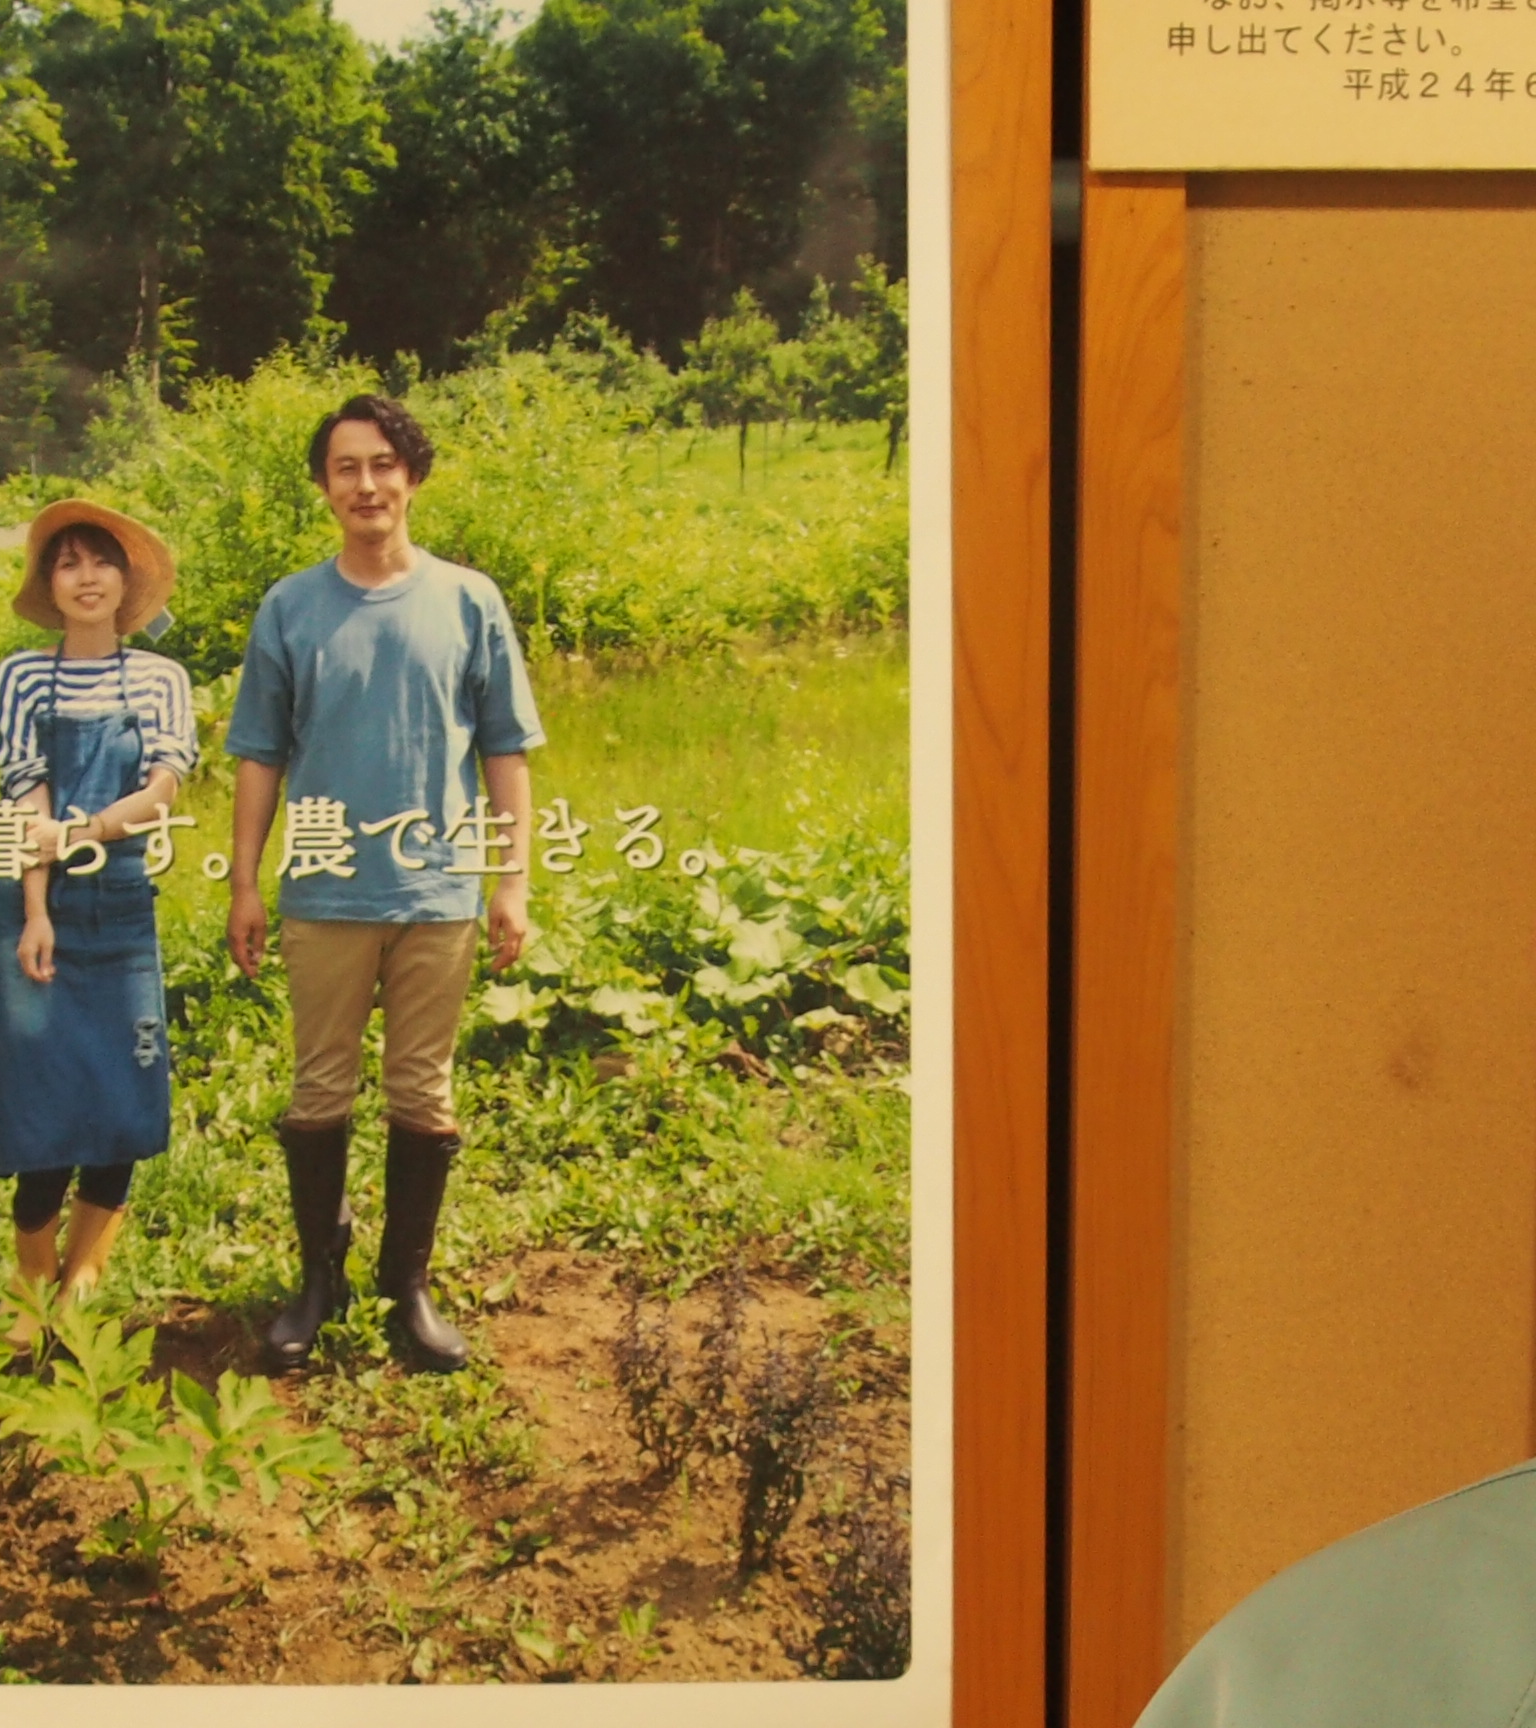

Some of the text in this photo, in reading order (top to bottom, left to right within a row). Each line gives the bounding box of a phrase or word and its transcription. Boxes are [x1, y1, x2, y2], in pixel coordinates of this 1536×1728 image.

[1166, 21, 1466, 57] 申し出てください。
